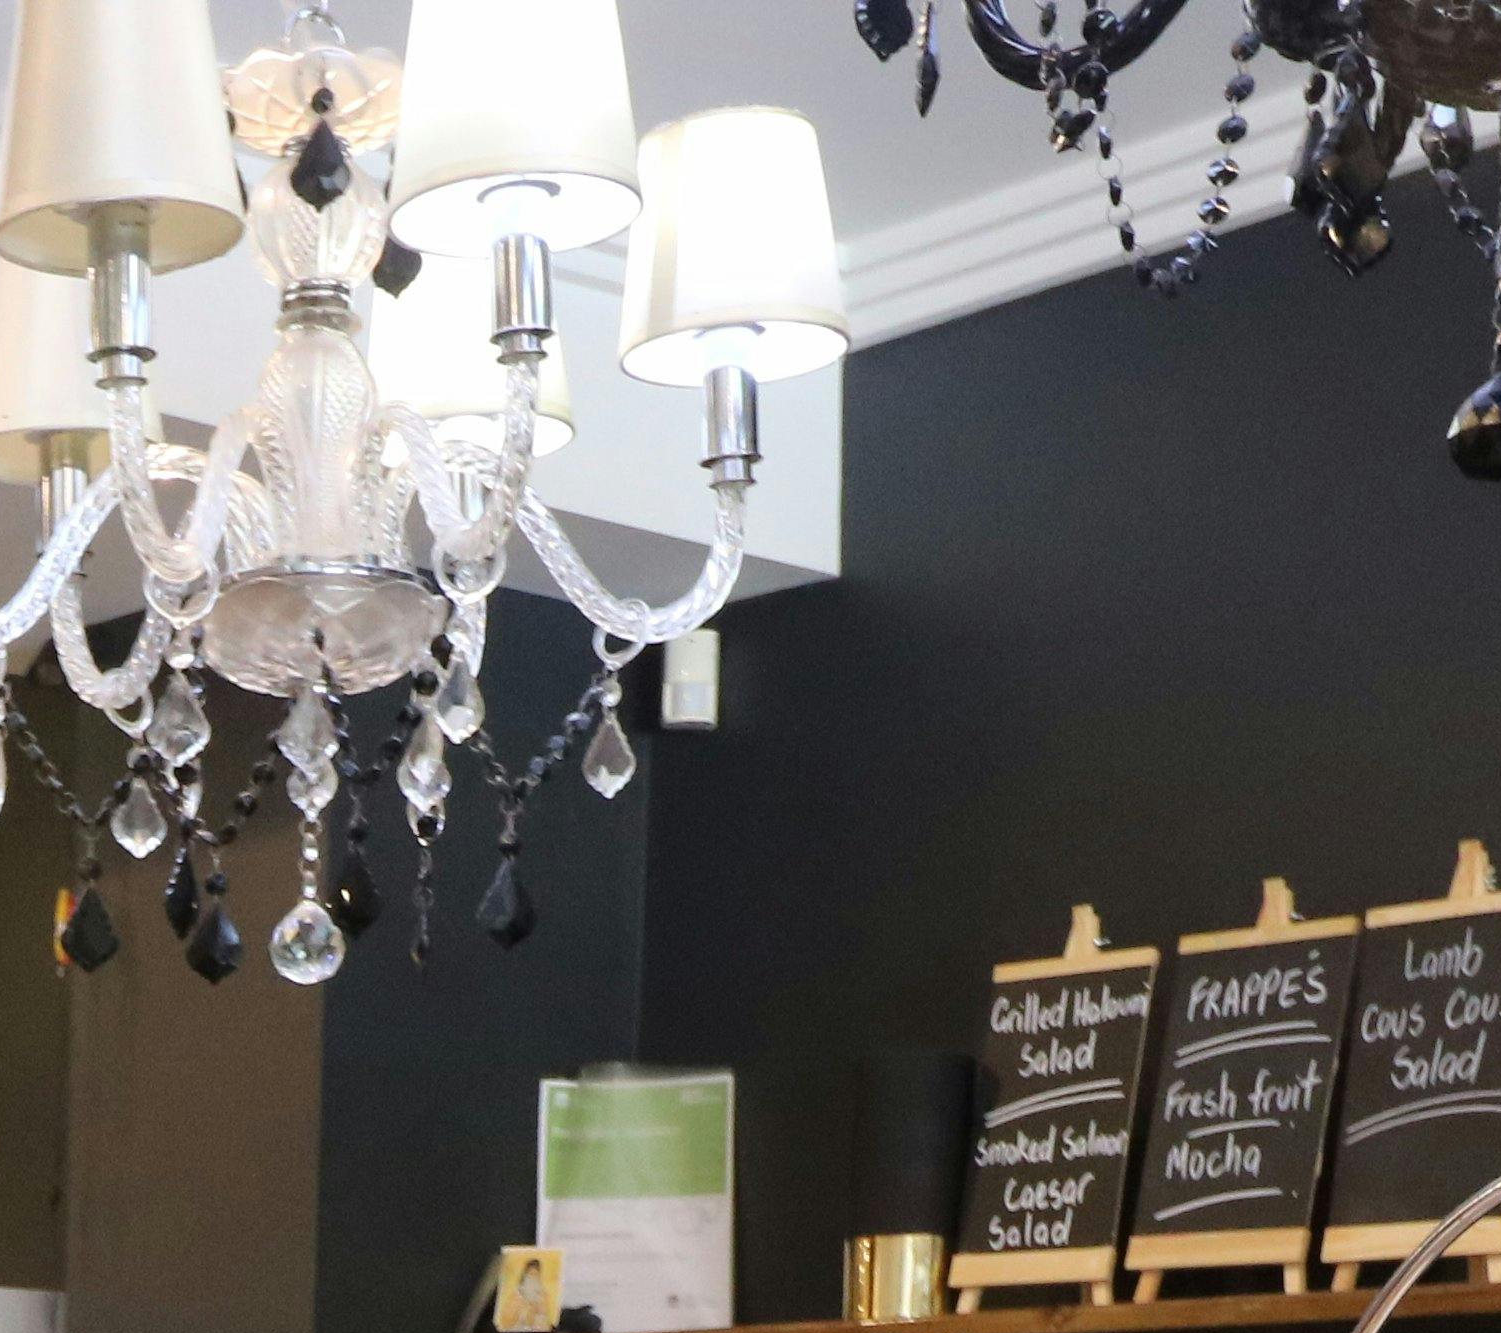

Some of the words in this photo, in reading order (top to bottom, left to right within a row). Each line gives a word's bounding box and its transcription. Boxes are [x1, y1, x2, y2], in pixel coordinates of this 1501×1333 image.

[1404, 926, 1484, 982] Lamb
[990, 987, 1070, 1034] Grilled
[1360, 1000, 1428, 1043] Cous
[1018, 1029, 1096, 1078] Salad
[1390, 1028, 1488, 1090] Salad
[1163, 1069, 1238, 1123] Fresh
[1248, 1058, 1324, 1118] fruit
[974, 1124, 1057, 1167] Smoked
[1062, 1119, 1129, 1161] Salmon
[1164, 1131, 1263, 1180] Mocha
[1003, 1171, 1096, 1213] Caesar
[988, 1206, 1073, 1250] Salad
